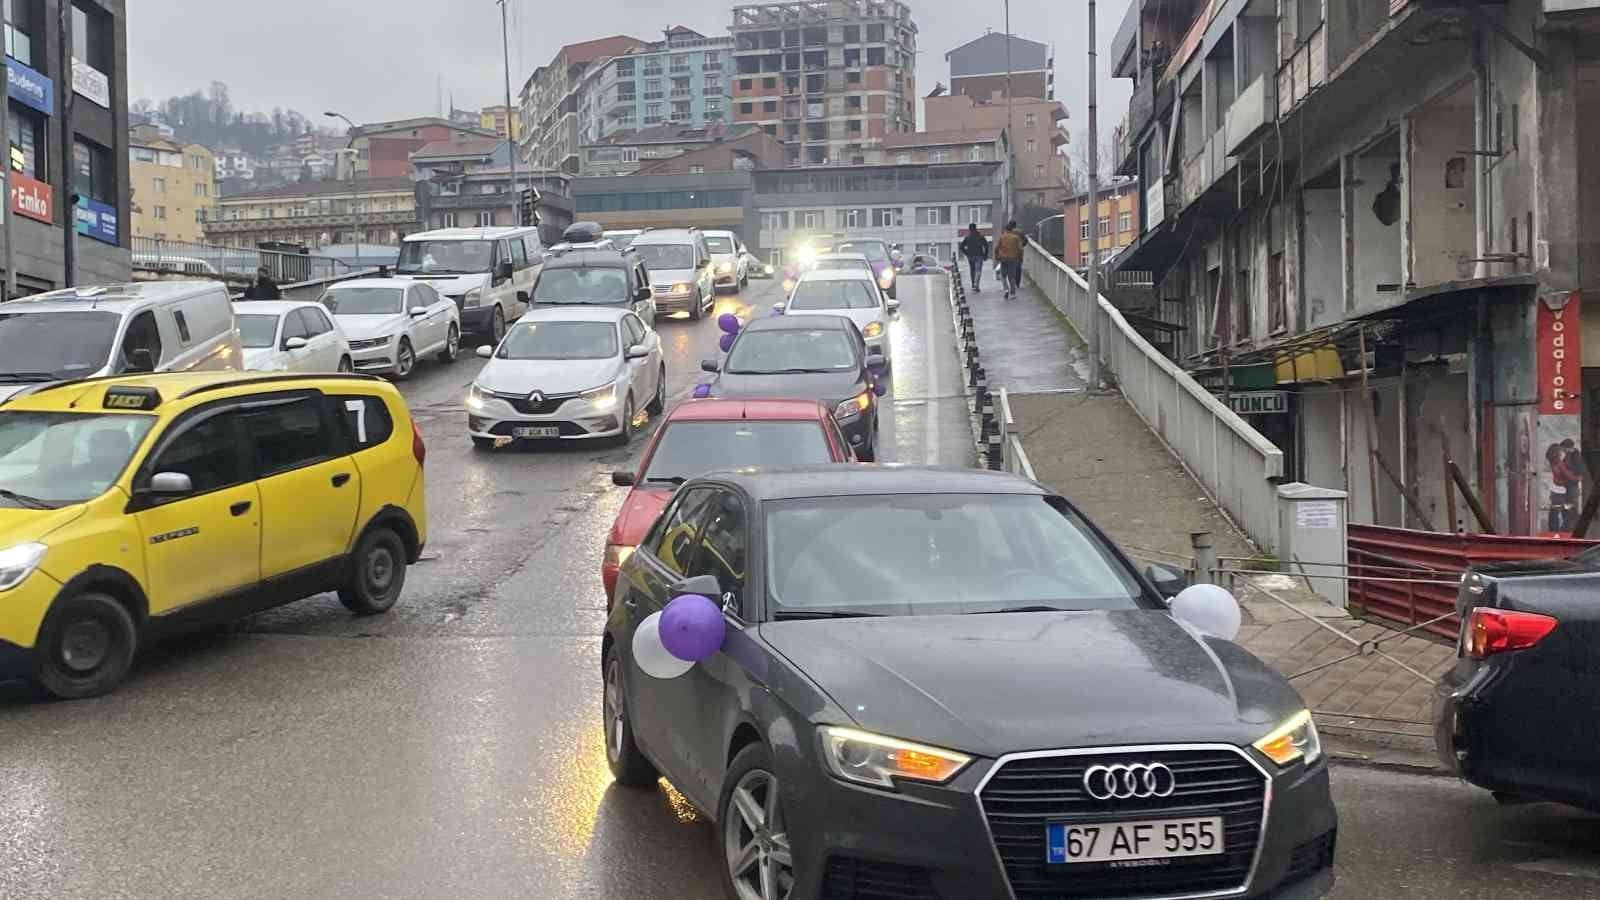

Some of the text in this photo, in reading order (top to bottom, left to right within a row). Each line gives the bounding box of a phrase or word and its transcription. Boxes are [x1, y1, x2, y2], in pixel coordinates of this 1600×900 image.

[18, 186, 47, 217] Emko
[1552, 310, 1565, 410] vodafone
[344, 399, 367, 443] 7
[1067, 821, 1215, 857] 67 AF 555
